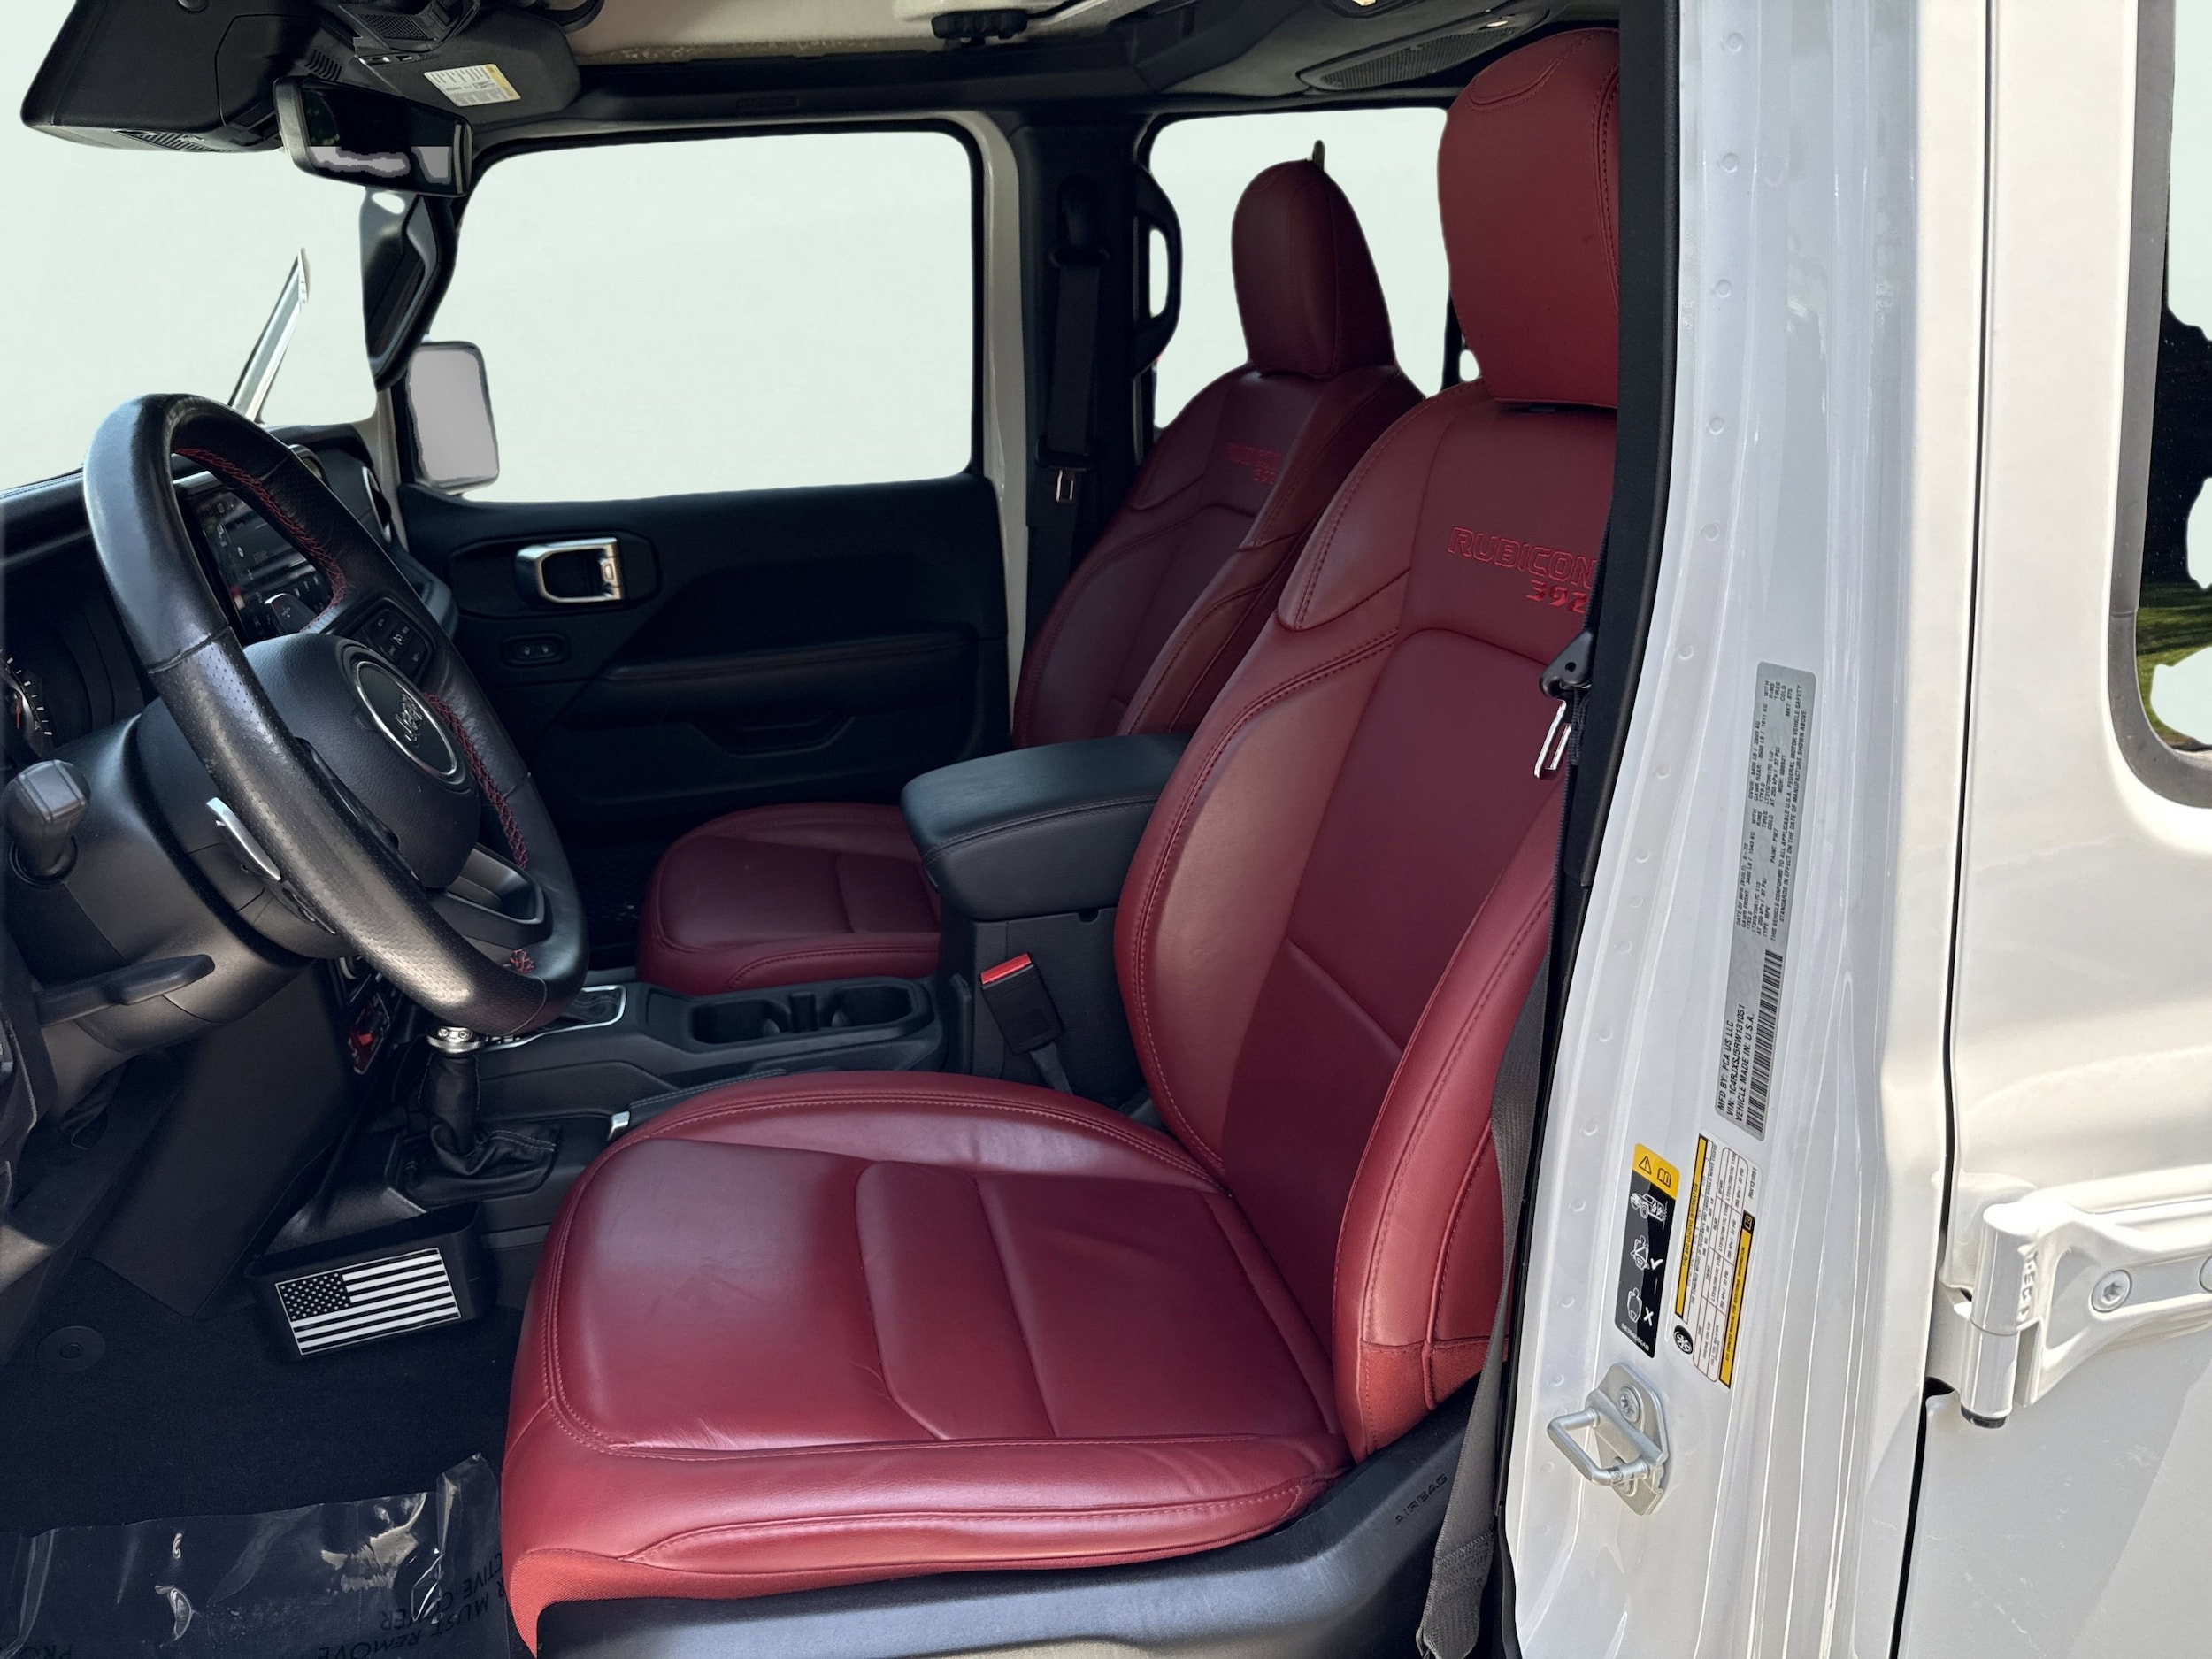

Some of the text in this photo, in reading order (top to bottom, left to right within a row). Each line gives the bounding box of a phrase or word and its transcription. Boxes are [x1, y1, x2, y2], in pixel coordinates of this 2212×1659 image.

[1446, 526, 1597, 589] RUBICON
[1526, 579, 1588, 614] 392
[1794, 683, 1803, 710] SAFETY
[1792, 709, 1801, 736] VEHICLE
[1786, 759, 1795, 788] FEDERAL
[1778, 886, 1788, 923] STANDARDS
[1791, 756, 1801, 803] MANUFACTURE
[1780, 809, 1790, 846] APPLICABLE
[1774, 868, 1783, 902] CONFORMS
[1717, 1018, 1733, 1111] MFD BY: FCA US LLC
[1735, 1010, 1754, 1123] VEHICLE MADE IN: U.S.A.
[1726, 1096, 1735, 1117] VIN:
[1394, 1472, 1449, 1526] AIRBAG
